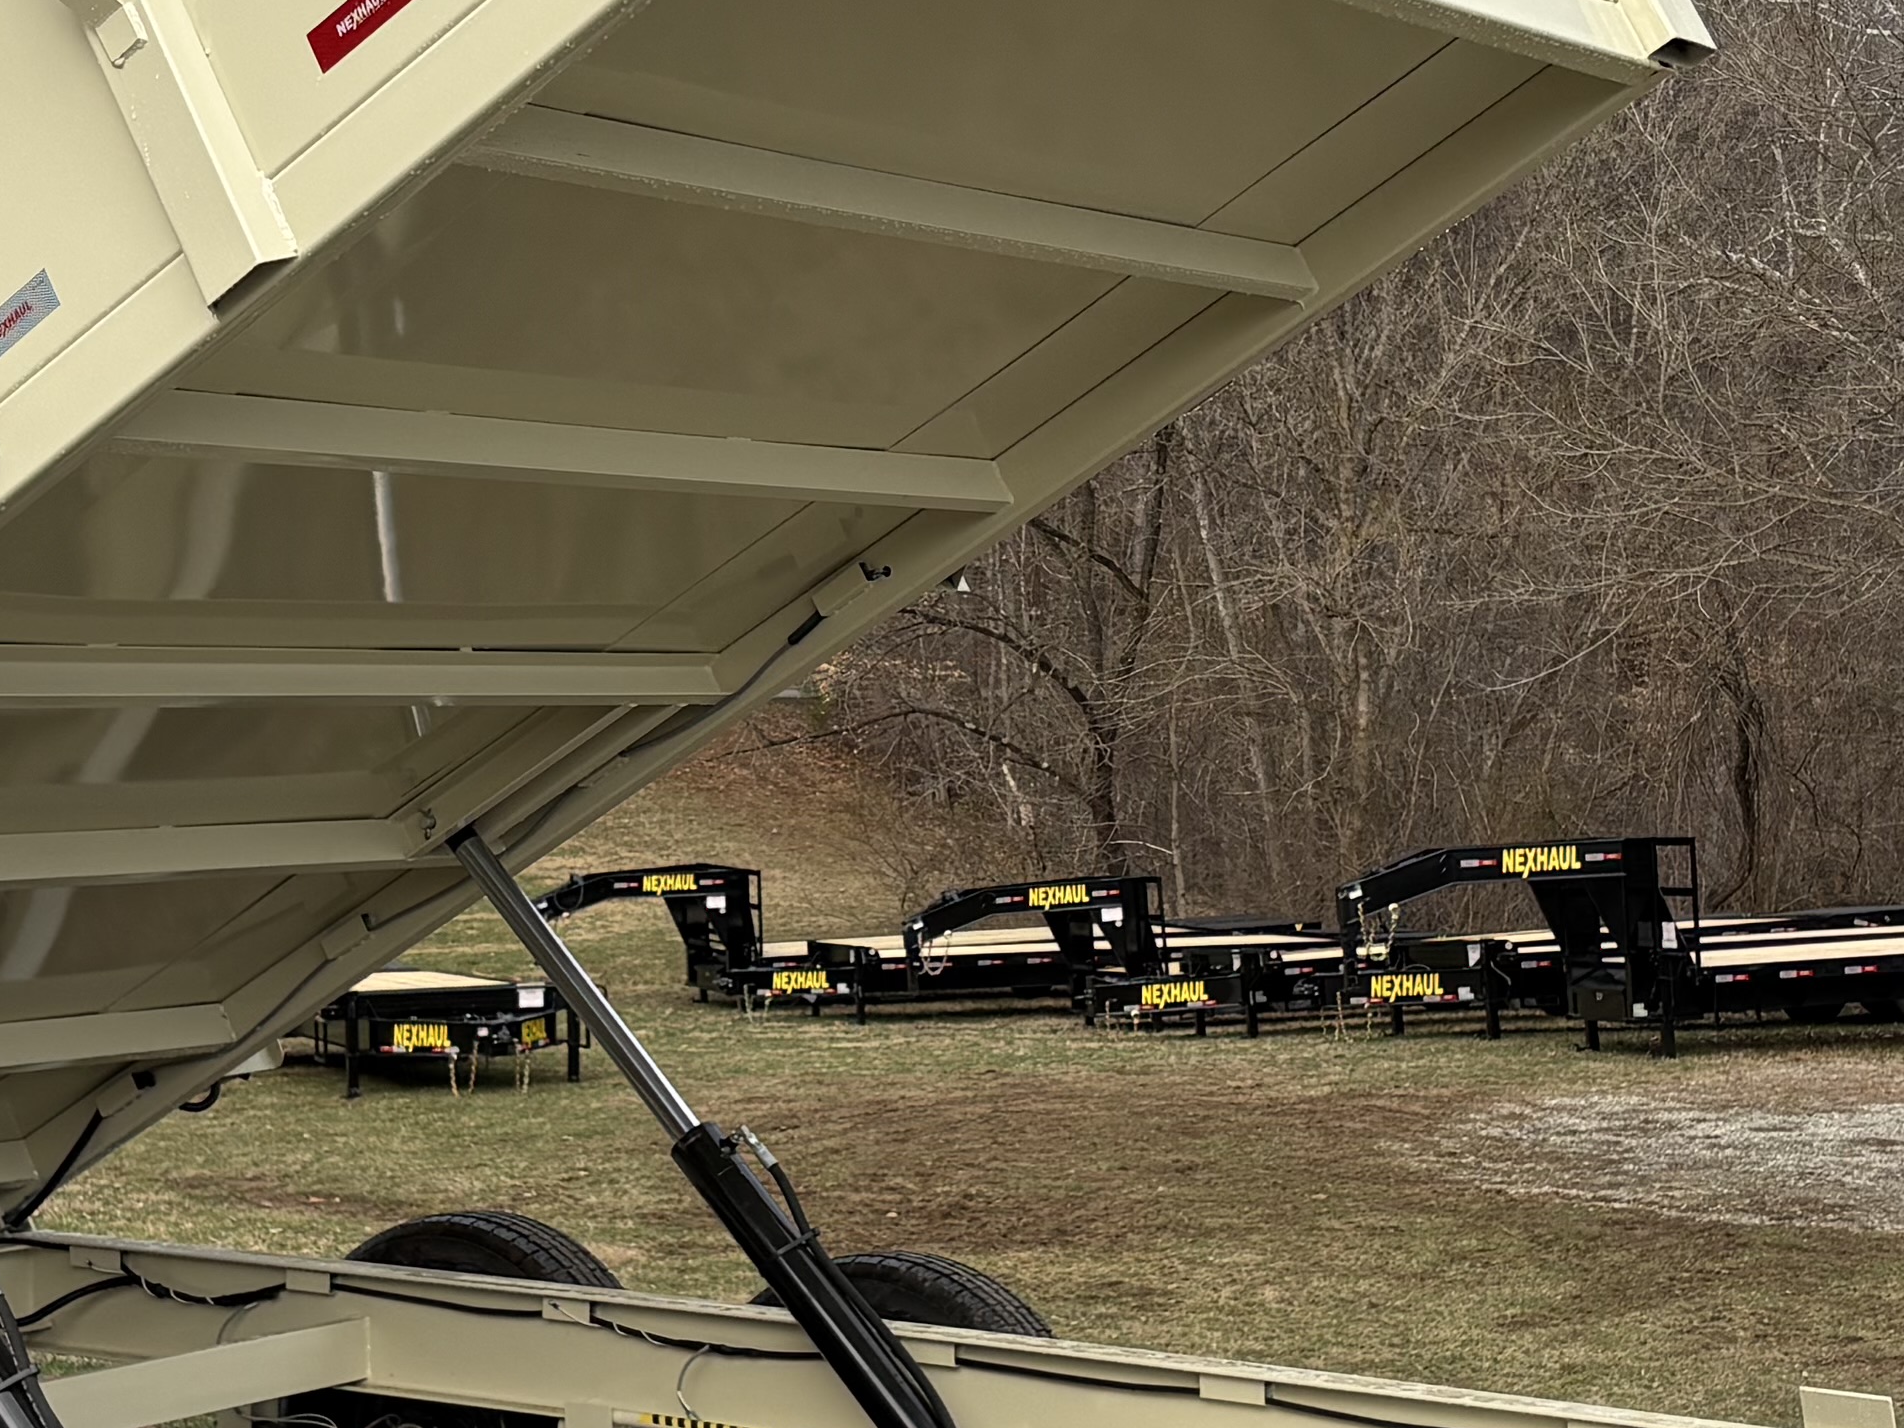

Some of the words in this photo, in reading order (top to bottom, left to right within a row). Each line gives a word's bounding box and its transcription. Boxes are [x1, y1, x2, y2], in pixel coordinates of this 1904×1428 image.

[1502, 845, 1582, 879] NEXHAUL
[642, 873, 698, 896] NEXHAUL
[1029, 883, 1090, 911] NEXHAUL
[772, 970, 830, 995] NEXHAUL
[1141, 980, 1209, 1010] NEXHAUL
[1370, 972, 1445, 1003] NEXHAUL
[393, 1023, 452, 1053] NEXHAUL
